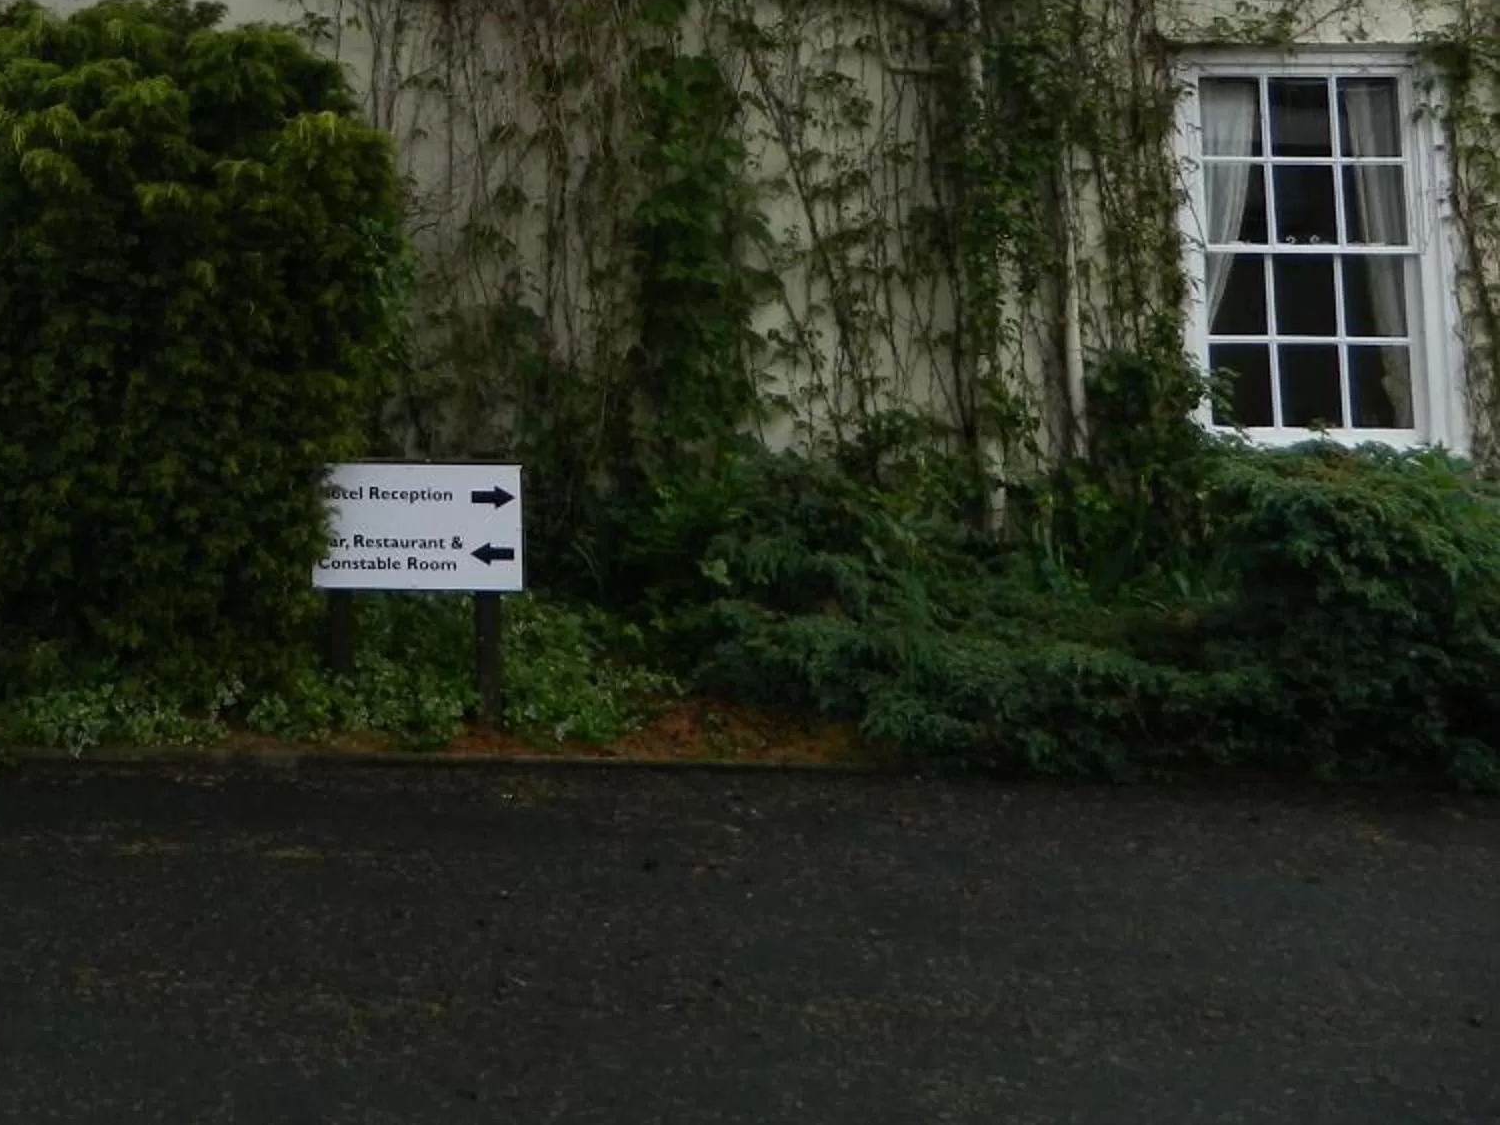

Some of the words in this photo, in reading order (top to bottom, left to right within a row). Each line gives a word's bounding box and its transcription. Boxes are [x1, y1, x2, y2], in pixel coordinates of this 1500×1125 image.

[324, 486, 363, 500] otel
[369, 486, 453, 504] Reception
[353, 534, 446, 549] Restaurant
[451, 536, 463, 549] &
[318, 556, 401, 570] Constable
[407, 556, 457, 571] Room
